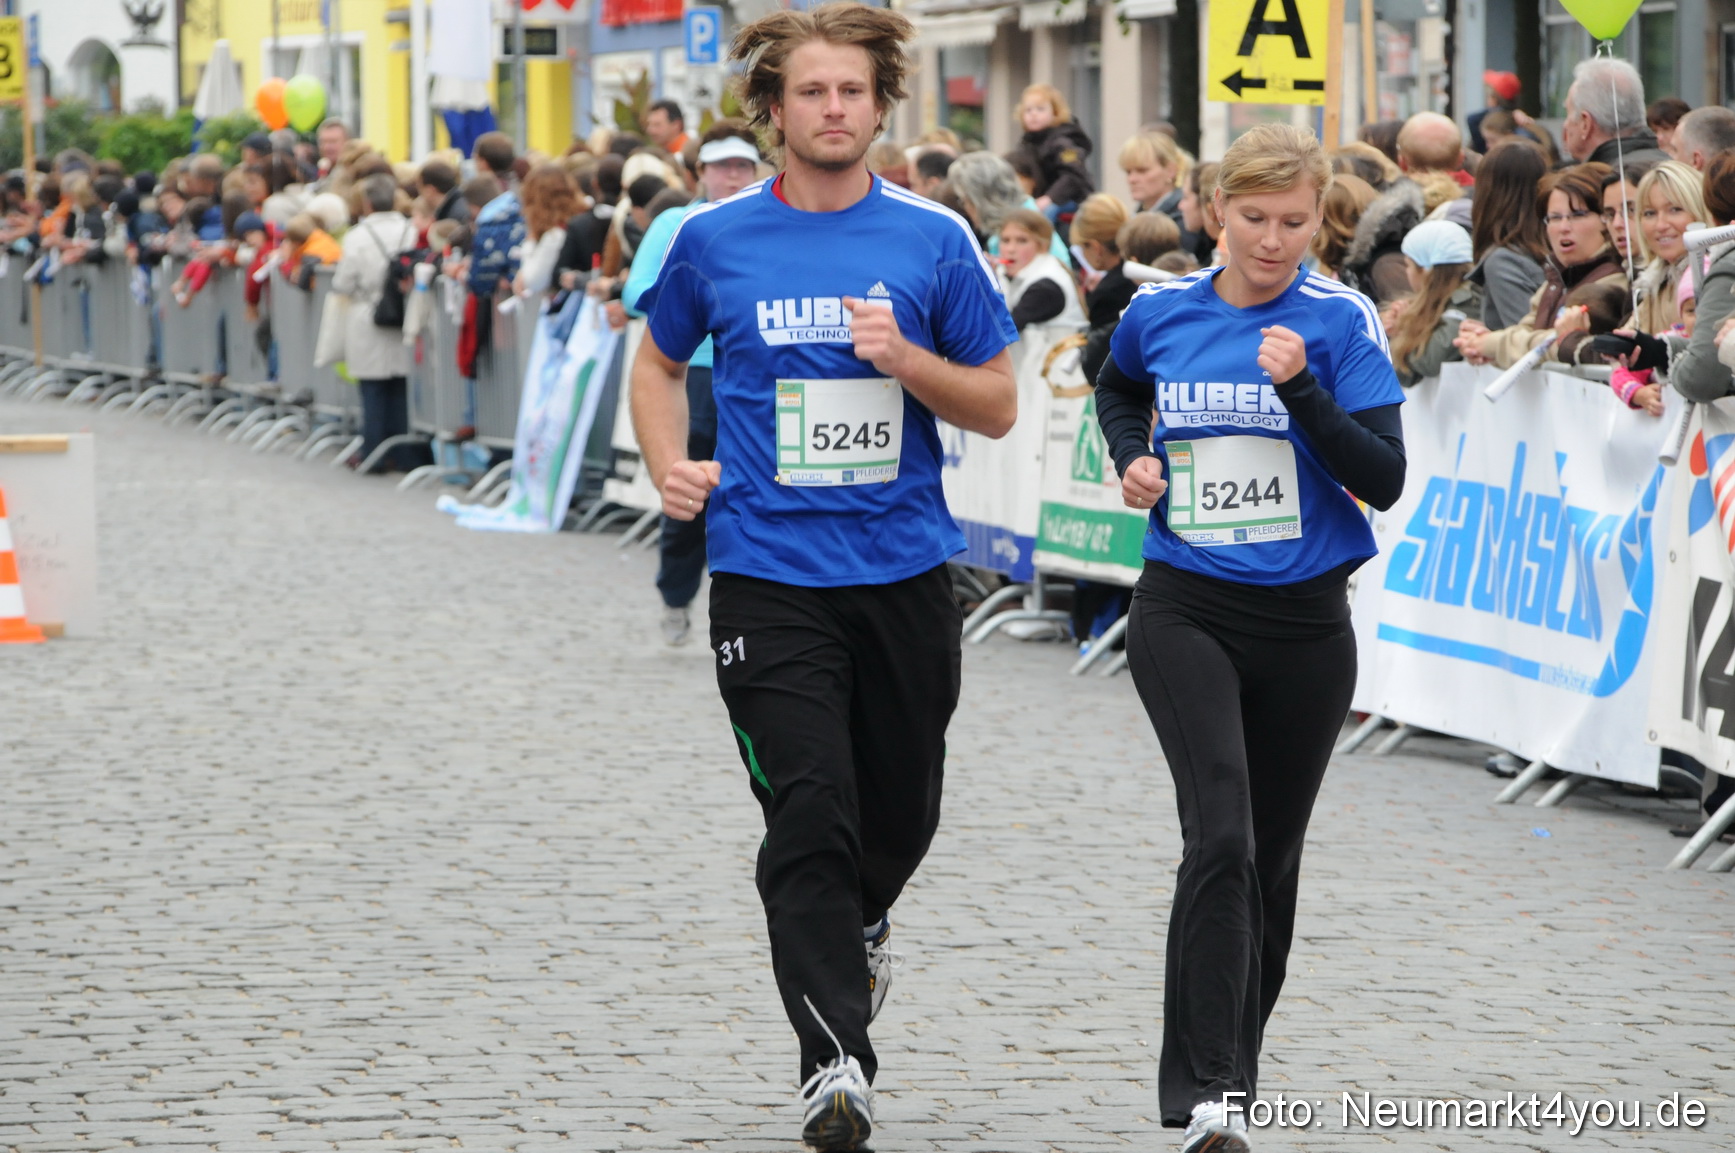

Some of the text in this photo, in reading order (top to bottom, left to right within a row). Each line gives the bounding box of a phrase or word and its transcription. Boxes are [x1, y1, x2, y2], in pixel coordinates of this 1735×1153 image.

[690, 14, 714, 59] P
[1237, 0, 1311, 58] A
[757, 297, 893, 330] HUB
[1158, 382, 1288, 414] HUBER
[1181, 413, 1283, 427] TECHNOLOGY
[812, 421, 890, 452] 5245
[856, 465, 897, 477] PFLEIDERER
[1201, 476, 1284, 511] 5244
[1248, 523, 1298, 535] PFLEIDERER
[719, 636, 746, 666] 31
